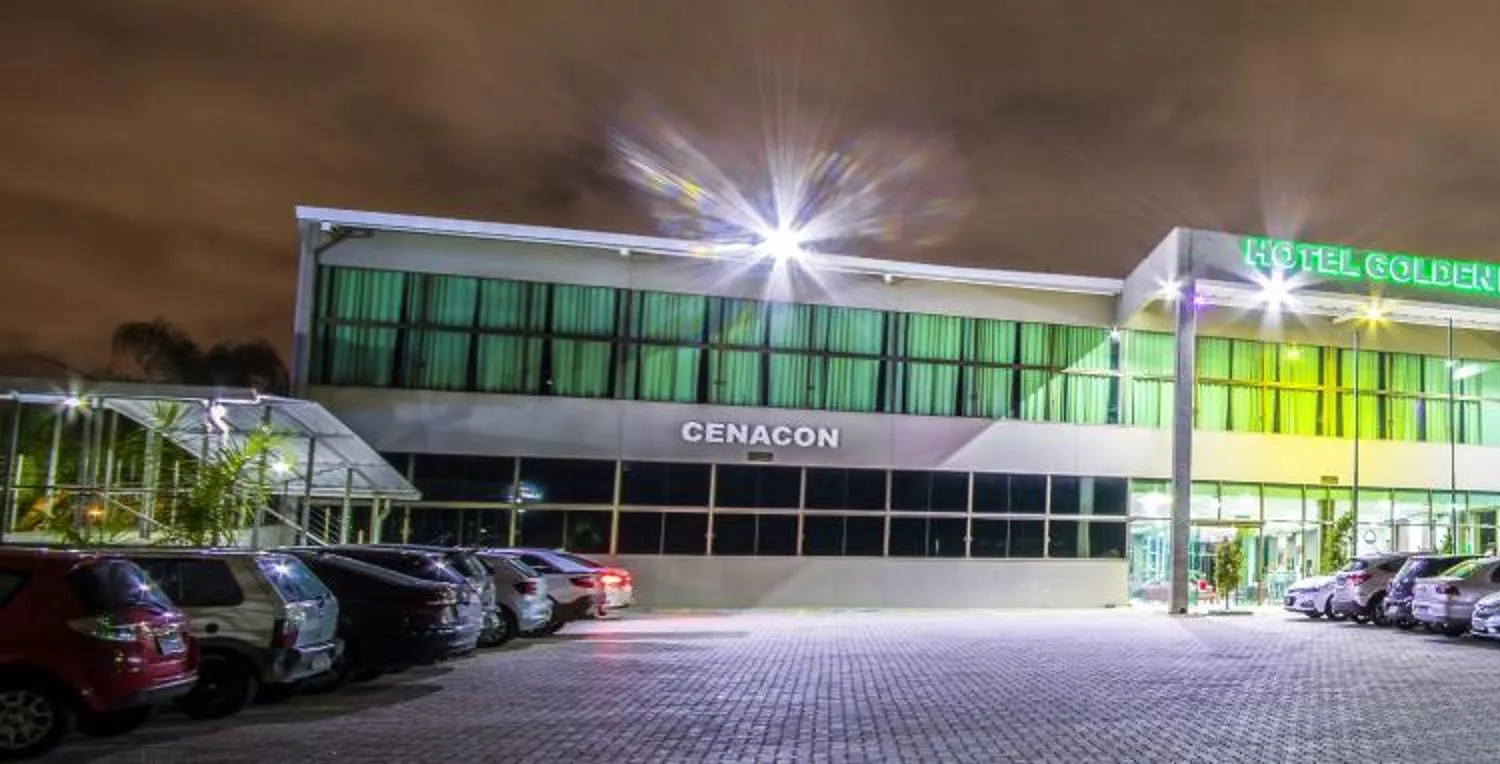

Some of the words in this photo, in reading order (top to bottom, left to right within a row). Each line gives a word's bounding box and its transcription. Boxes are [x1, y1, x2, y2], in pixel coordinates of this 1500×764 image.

[1246, 238, 1360, 277] HOTEL
[1364, 251, 1496, 290] GOLDEN
[681, 421, 839, 449] CENACON
